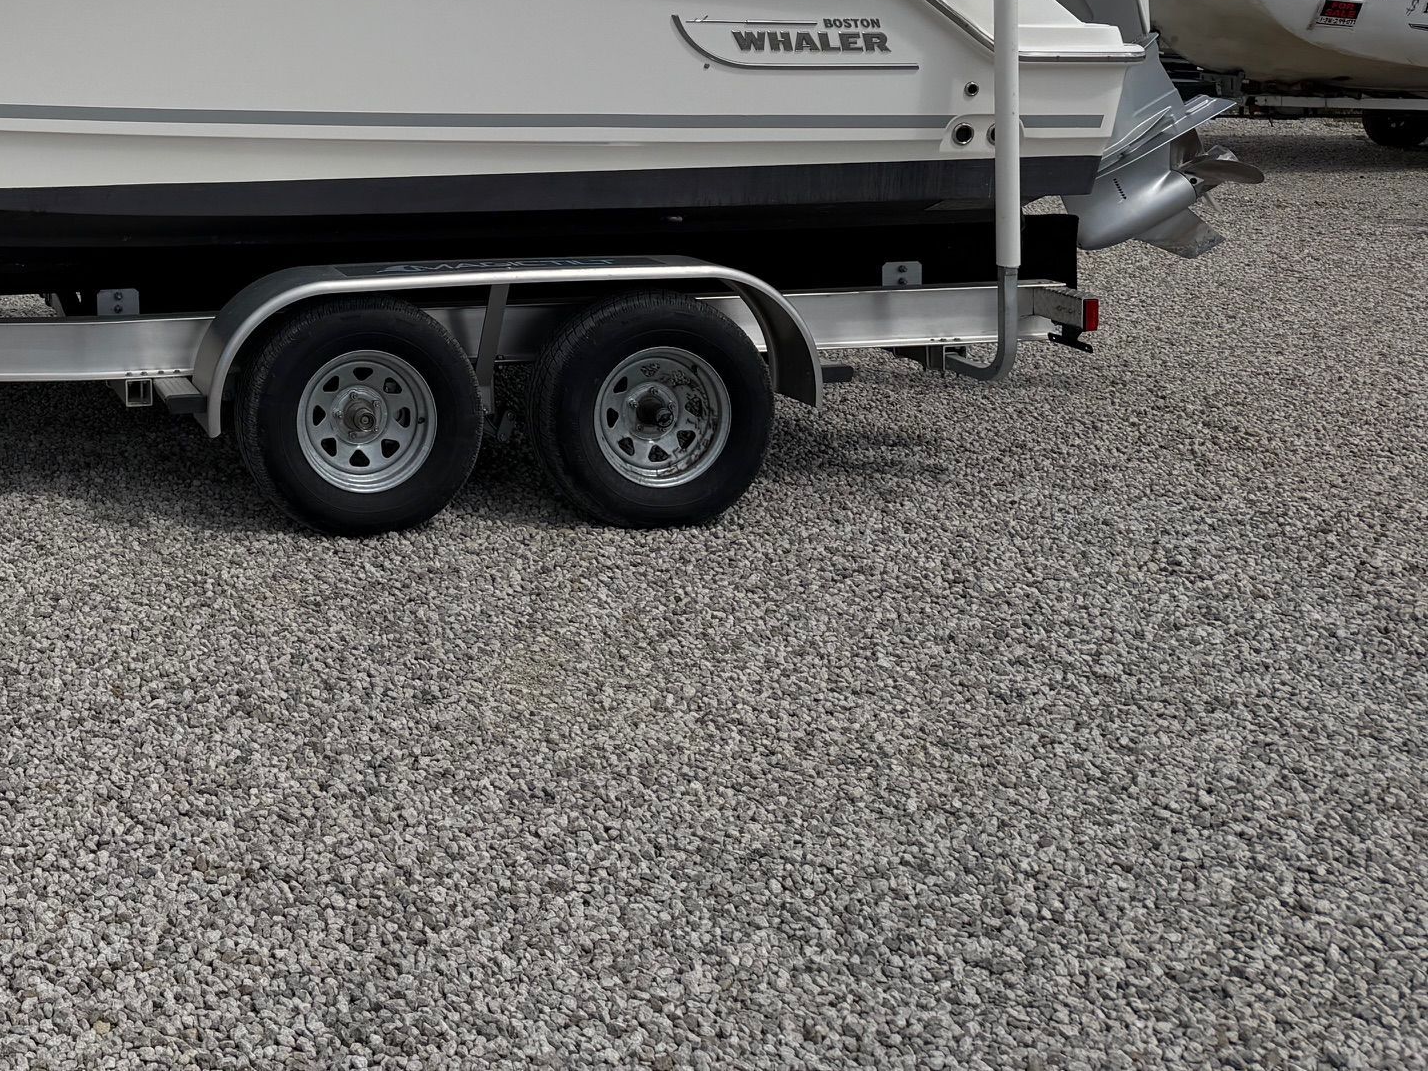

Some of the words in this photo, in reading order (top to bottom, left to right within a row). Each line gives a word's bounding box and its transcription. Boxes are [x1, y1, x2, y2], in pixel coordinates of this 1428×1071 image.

[1330, 0, 1356, 10] FOR
[1324, 8, 1356, 19] SALE
[822, 17, 882, 29] BOSTON
[730, 29, 892, 54] WHALER
